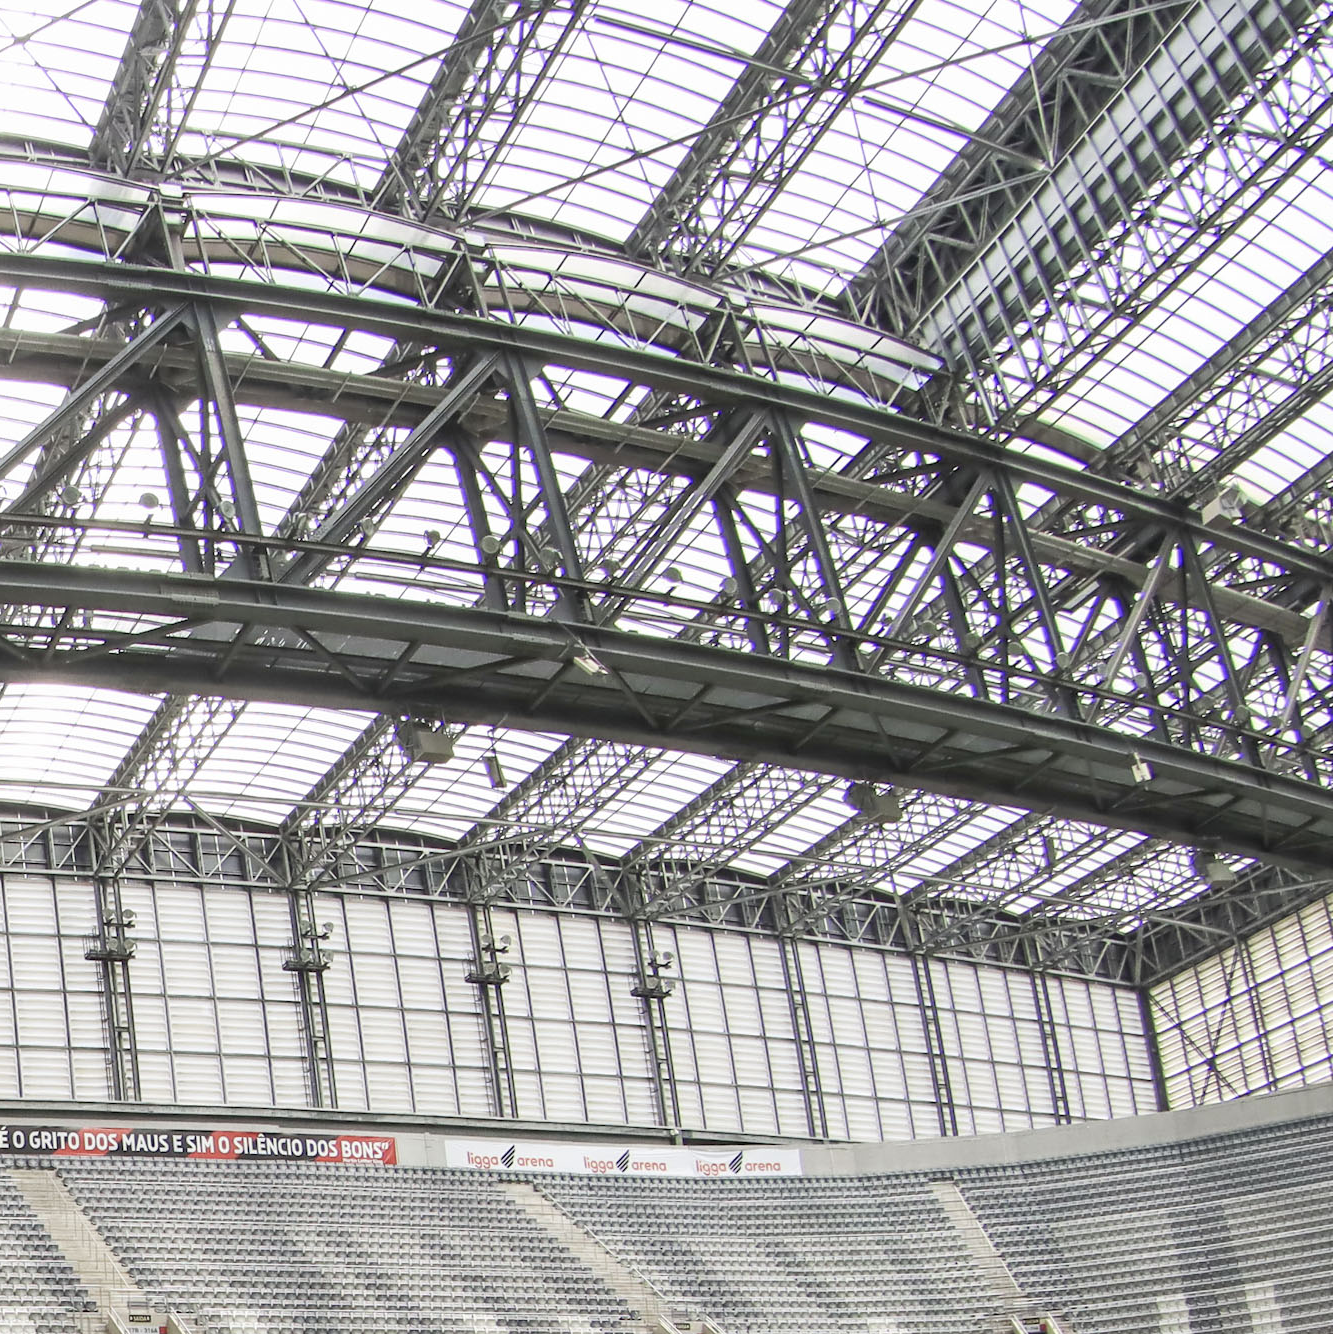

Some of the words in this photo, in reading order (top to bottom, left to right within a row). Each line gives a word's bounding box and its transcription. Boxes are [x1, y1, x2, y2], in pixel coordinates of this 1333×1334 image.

[12, 1130, 24, 1149] O
[29, 1131, 80, 1150] GRITO
[84, 1132, 118, 1150] DOS
[122, 1132, 169, 1152] MAUS
[173, 1135, 182, 1152] E
[185, 1135, 214, 1153] SIM
[218, 1136, 230, 1154] O
[234, 1134, 303, 1157] SILÊNCIO
[307, 1139, 337, 1158] DOS
[467, 1151, 499, 1169] ligga
[517, 1156, 554, 1168] arena
[583, 1156, 614, 1174] ligga
[631, 1161, 667, 1172] arena
[695, 1159, 727, 1177] ligga
[744, 1160, 781, 1172] arena
